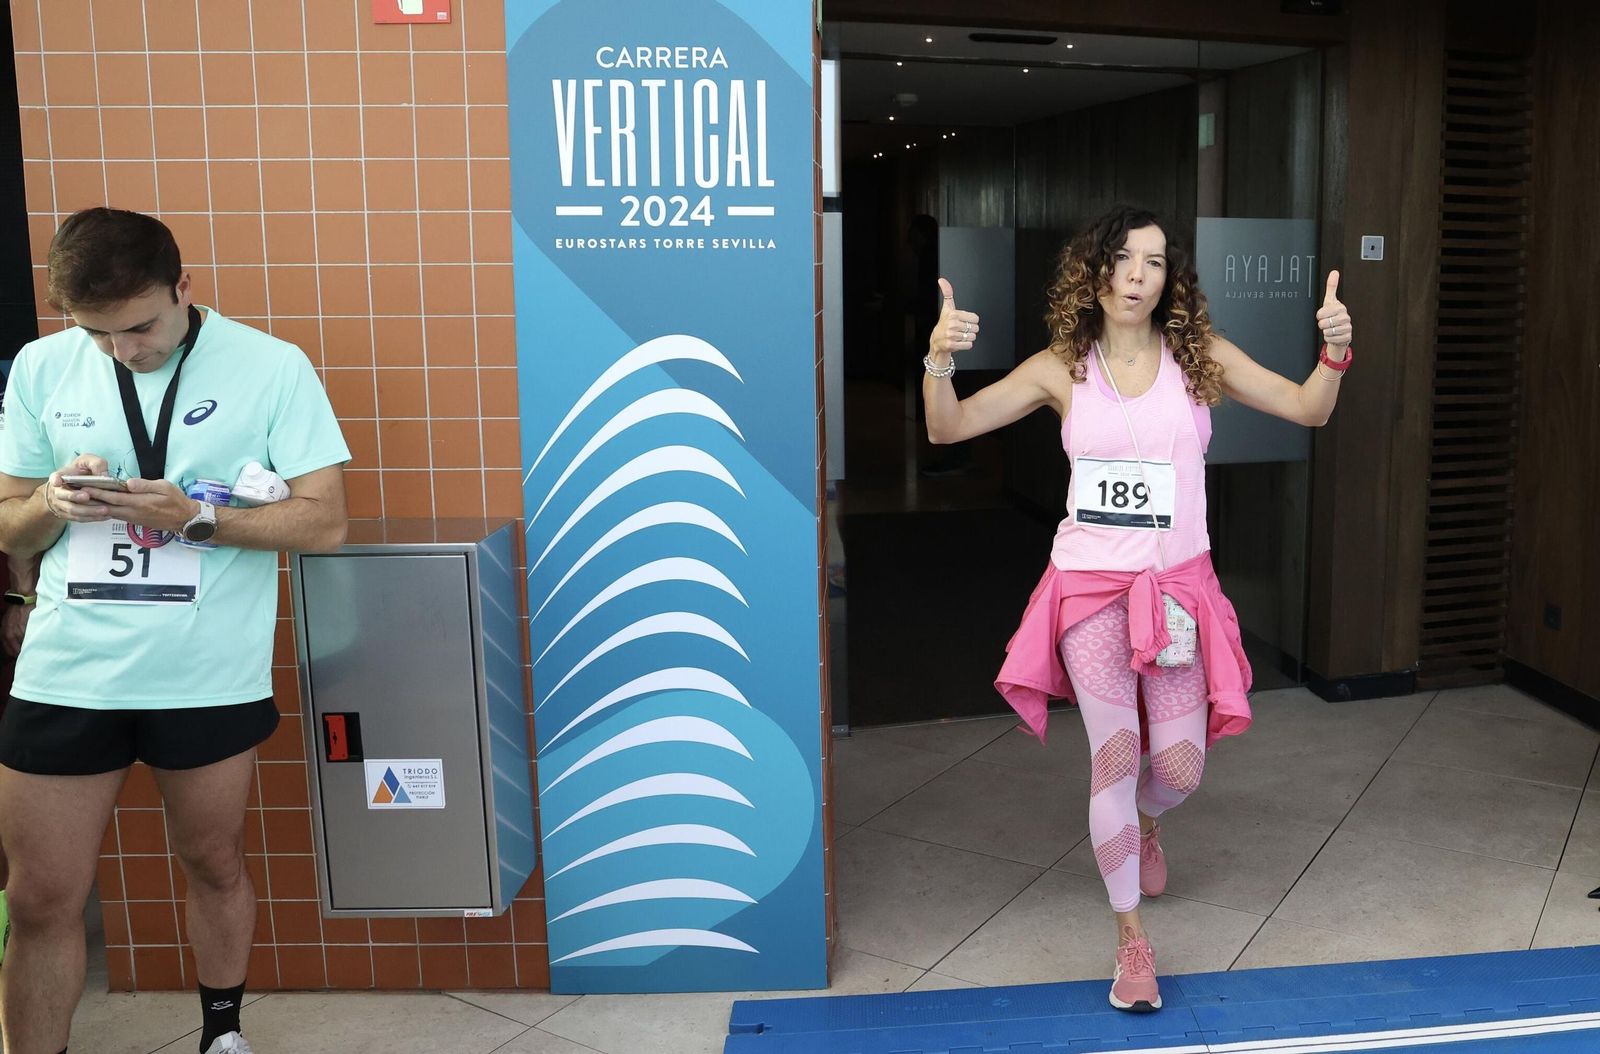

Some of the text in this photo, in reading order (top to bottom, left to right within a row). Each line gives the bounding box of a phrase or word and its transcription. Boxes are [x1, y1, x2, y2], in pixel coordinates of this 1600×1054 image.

[596, 46, 728, 68] CARRERA
[552, 79, 775, 188] VERTICAL
[620, 195, 714, 226] 2024
[556, 238, 776, 249] EUROSTARS TORRE SEVILLA
[1098, 480, 1151, 509] 189
[109, 543, 151, 578] 51
